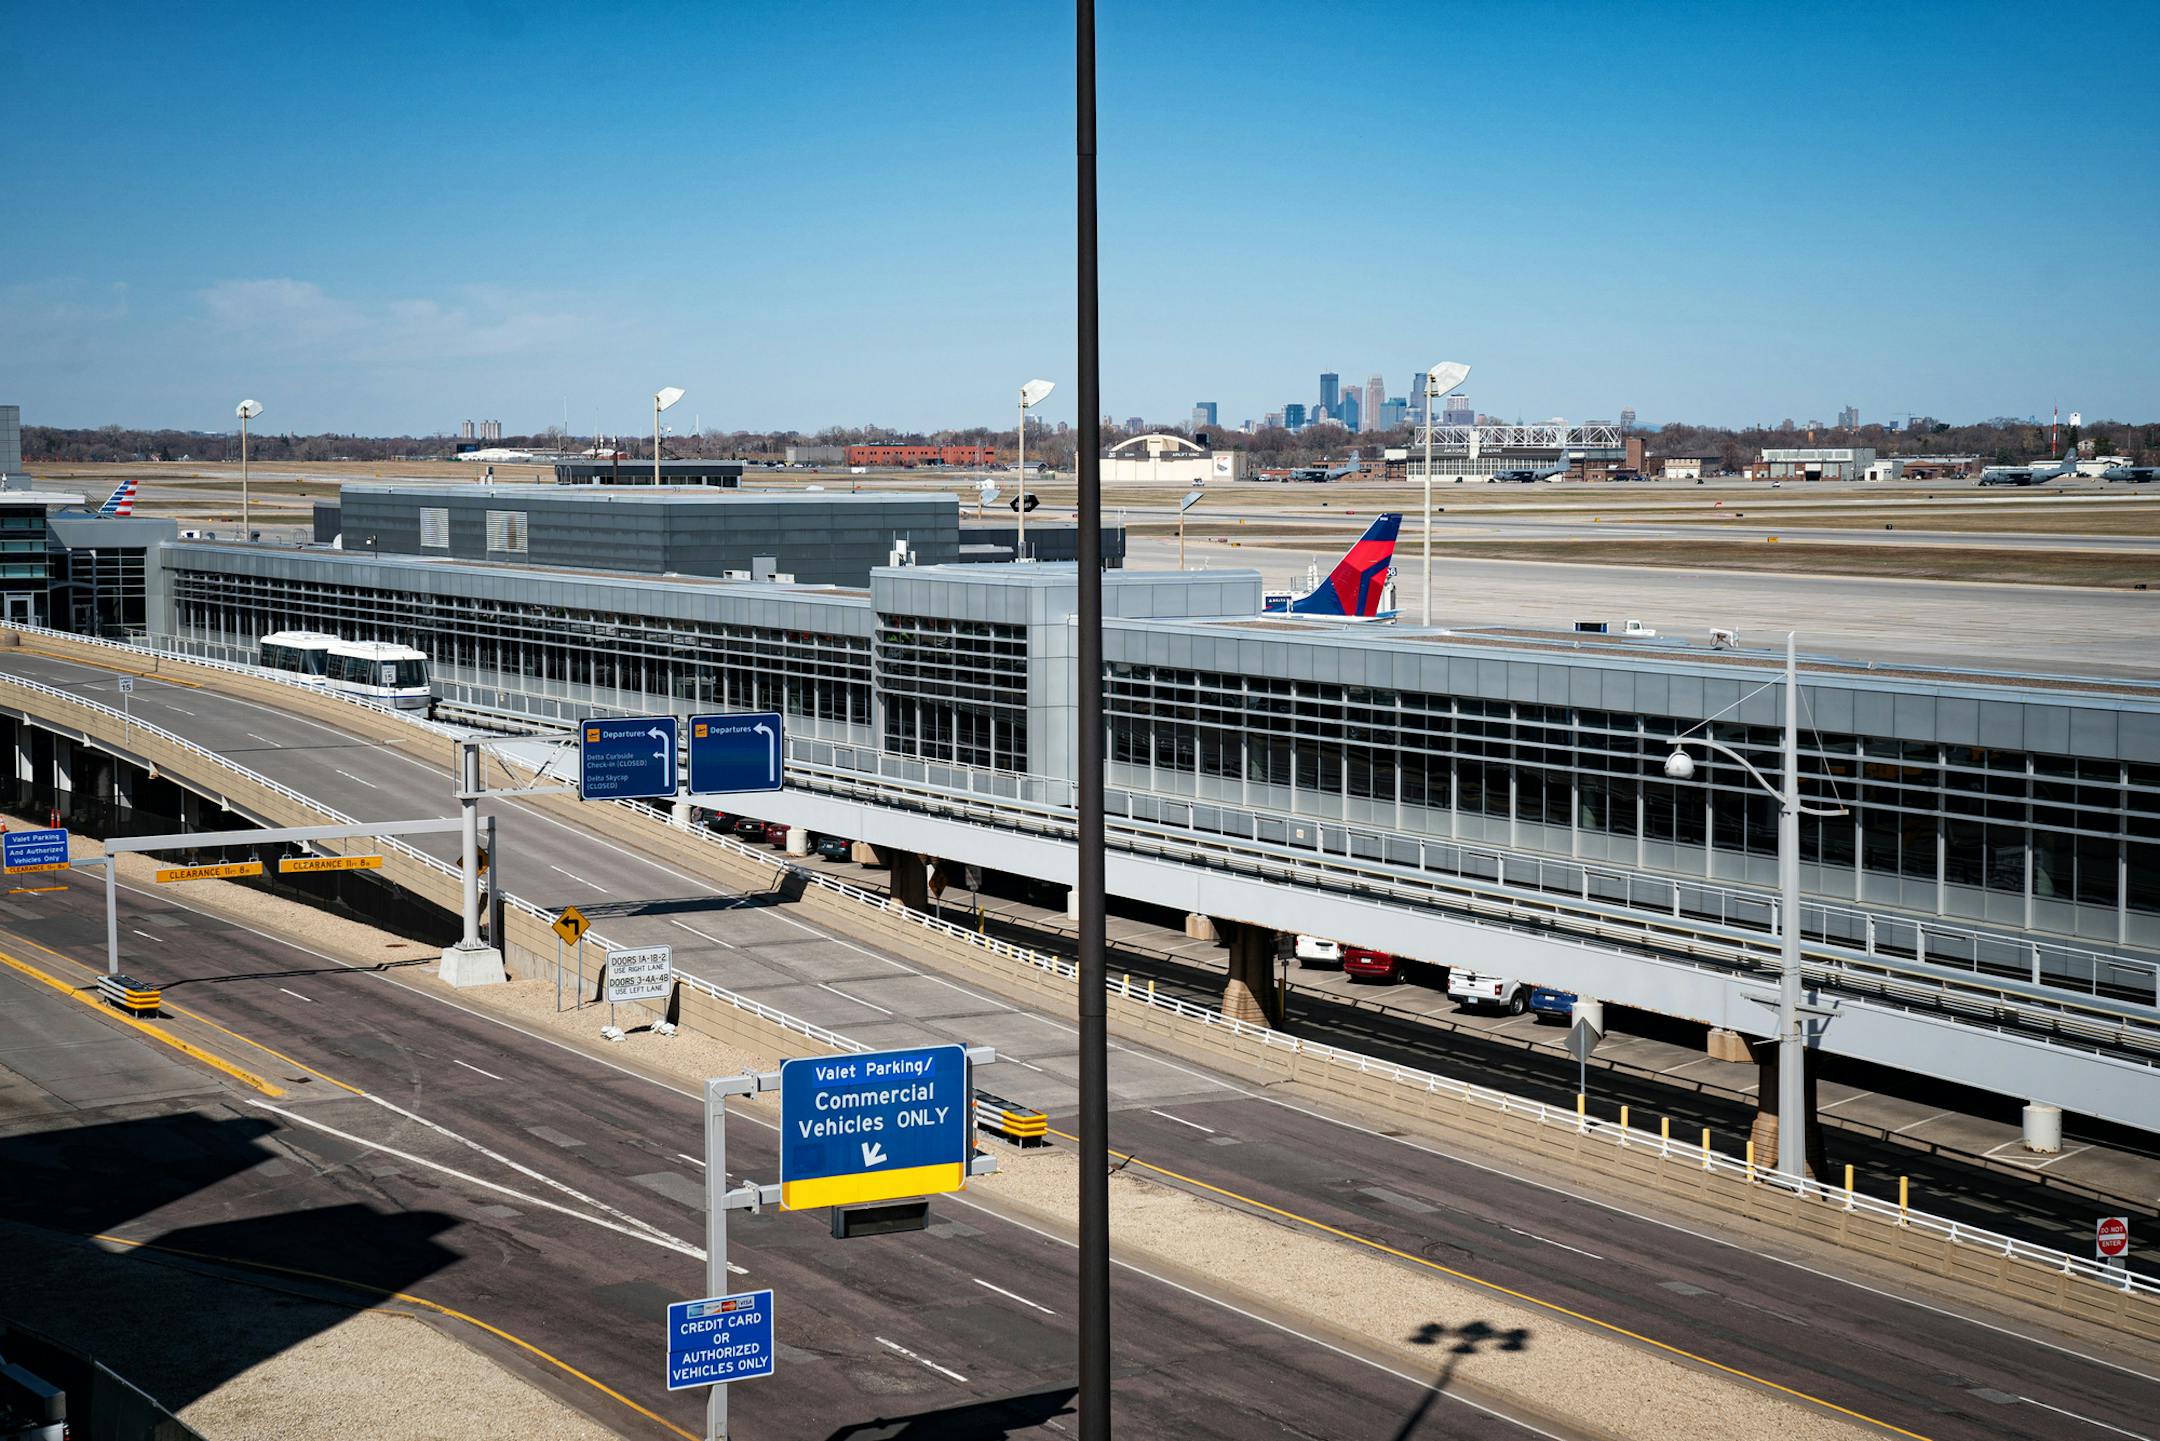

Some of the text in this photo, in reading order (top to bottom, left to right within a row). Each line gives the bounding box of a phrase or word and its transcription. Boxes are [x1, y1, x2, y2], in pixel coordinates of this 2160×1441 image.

[602, 730, 646, 740] Departures
[710, 726, 751, 735] Departures
[617, 760, 648, 768] (CLOSED)
[26, 847, 64, 855] Authorized
[293, 860, 343, 870] CLEARANCE
[169, 868, 220, 879] CLEARANCE
[612, 955, 637, 966] DOORS
[610, 976, 634, 987] DOORS
[816, 1057, 932, 1081] Valet Parking/
[815, 1082, 934, 1111] Commercial
[798, 1106, 949, 1139] Vehicles ONLY
[680, 1312, 762, 1335] CREDIT CARD
[713, 1332, 730, 1345] OR
[682, 1343, 760, 1364] AUTHORIZED
[673, 1356, 768, 1381] VEHICLES ONLY
